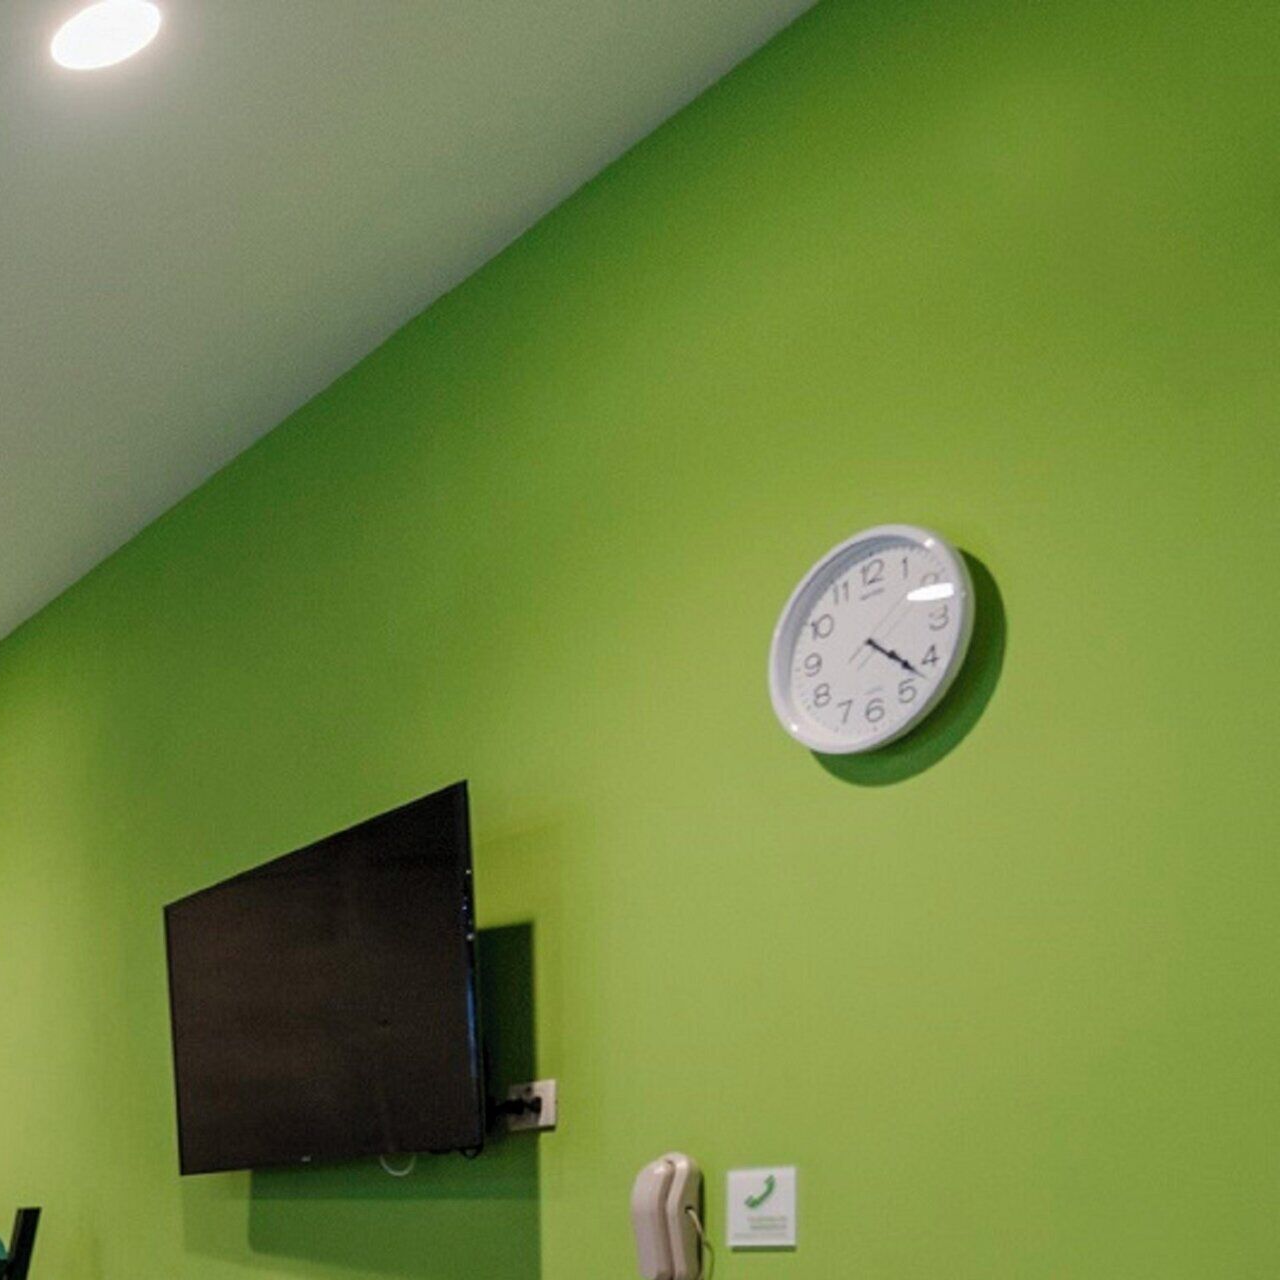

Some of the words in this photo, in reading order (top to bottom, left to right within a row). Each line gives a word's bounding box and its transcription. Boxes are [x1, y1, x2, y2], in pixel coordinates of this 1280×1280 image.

[861, 558, 885, 585] 12
[901, 556, 910, 579] 1
[832, 581, 849, 604] 11
[811, 613, 834, 640] 10
[928, 604, 949, 631] 3
[803, 652, 823, 678] 9
[921, 644, 940, 666] 4
[814, 682, 832, 708] 8
[897, 678, 917, 704] 5
[837, 699, 853, 724] 7
[864, 698, 885, 723] 6
